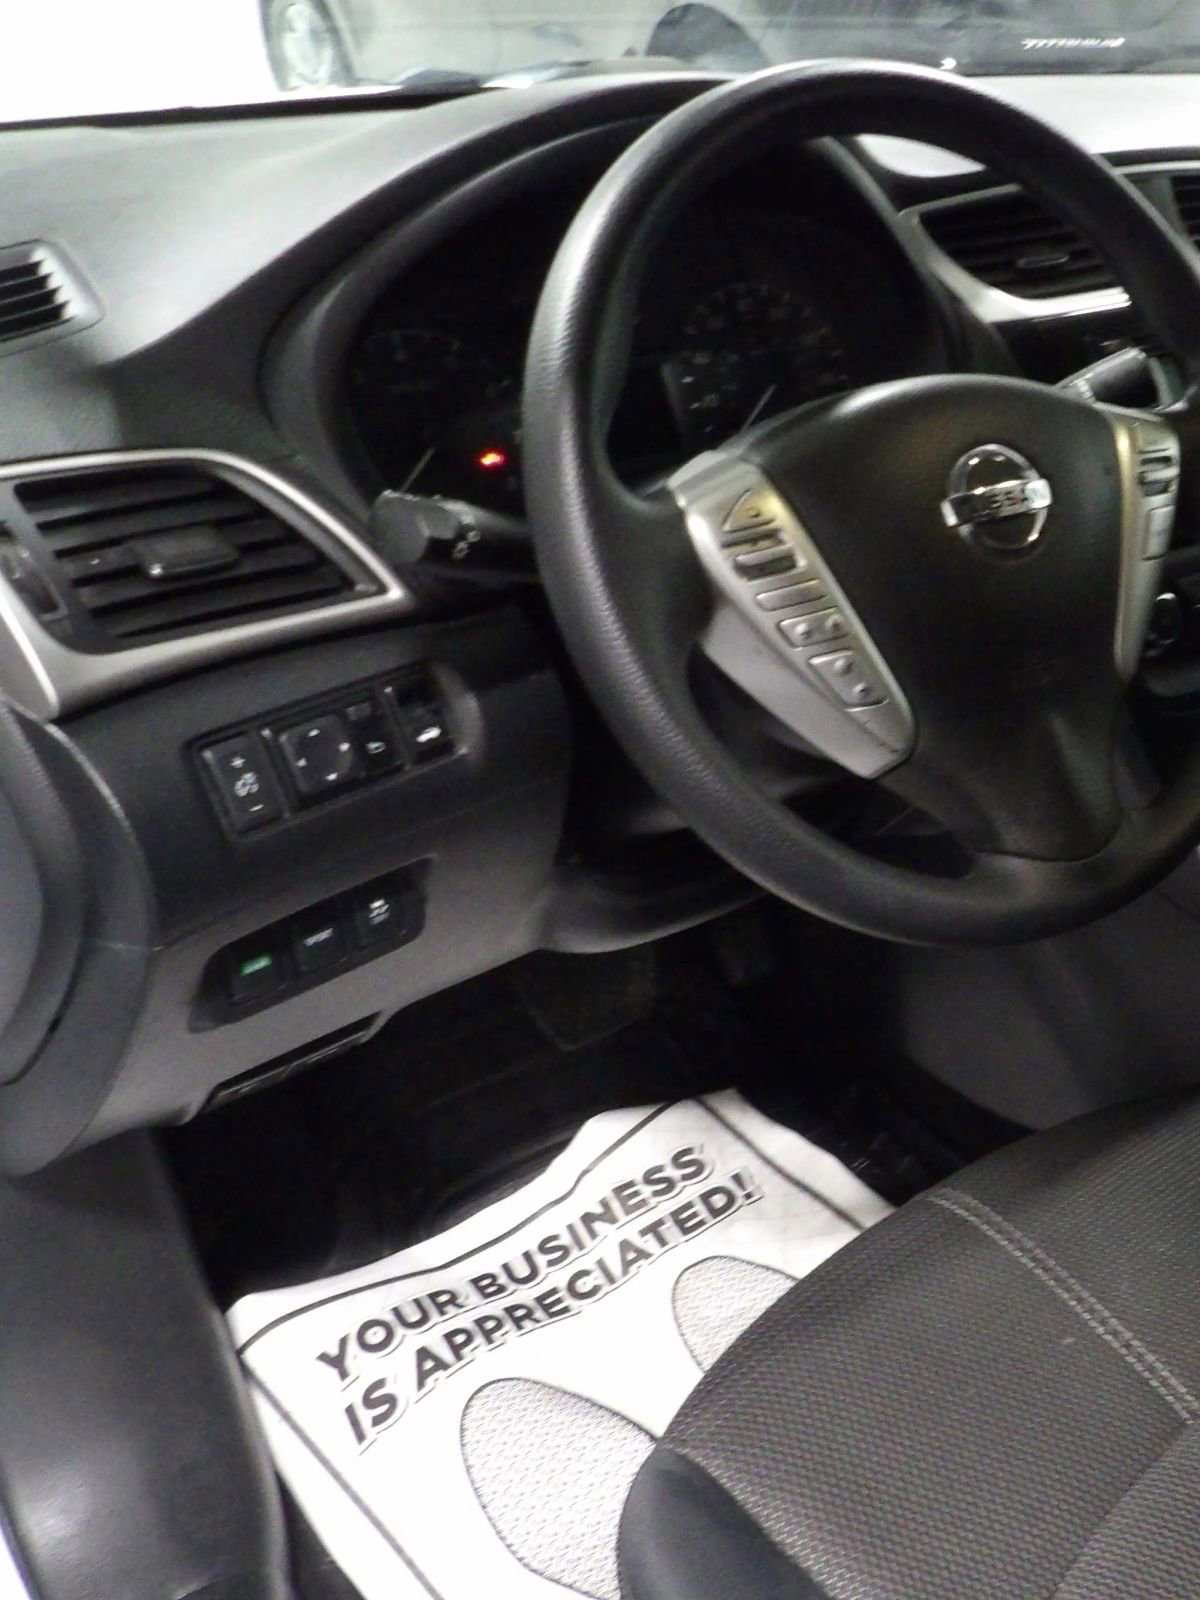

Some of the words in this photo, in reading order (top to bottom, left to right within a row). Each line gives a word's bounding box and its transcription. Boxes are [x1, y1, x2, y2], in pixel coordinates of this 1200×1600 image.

[315, 1288, 466, 1382] YOUR
[468, 1146, 706, 1301] BUSINESS
[343, 1376, 399, 1446] IS
[414, 1171, 755, 1394] APPRECIATED!
